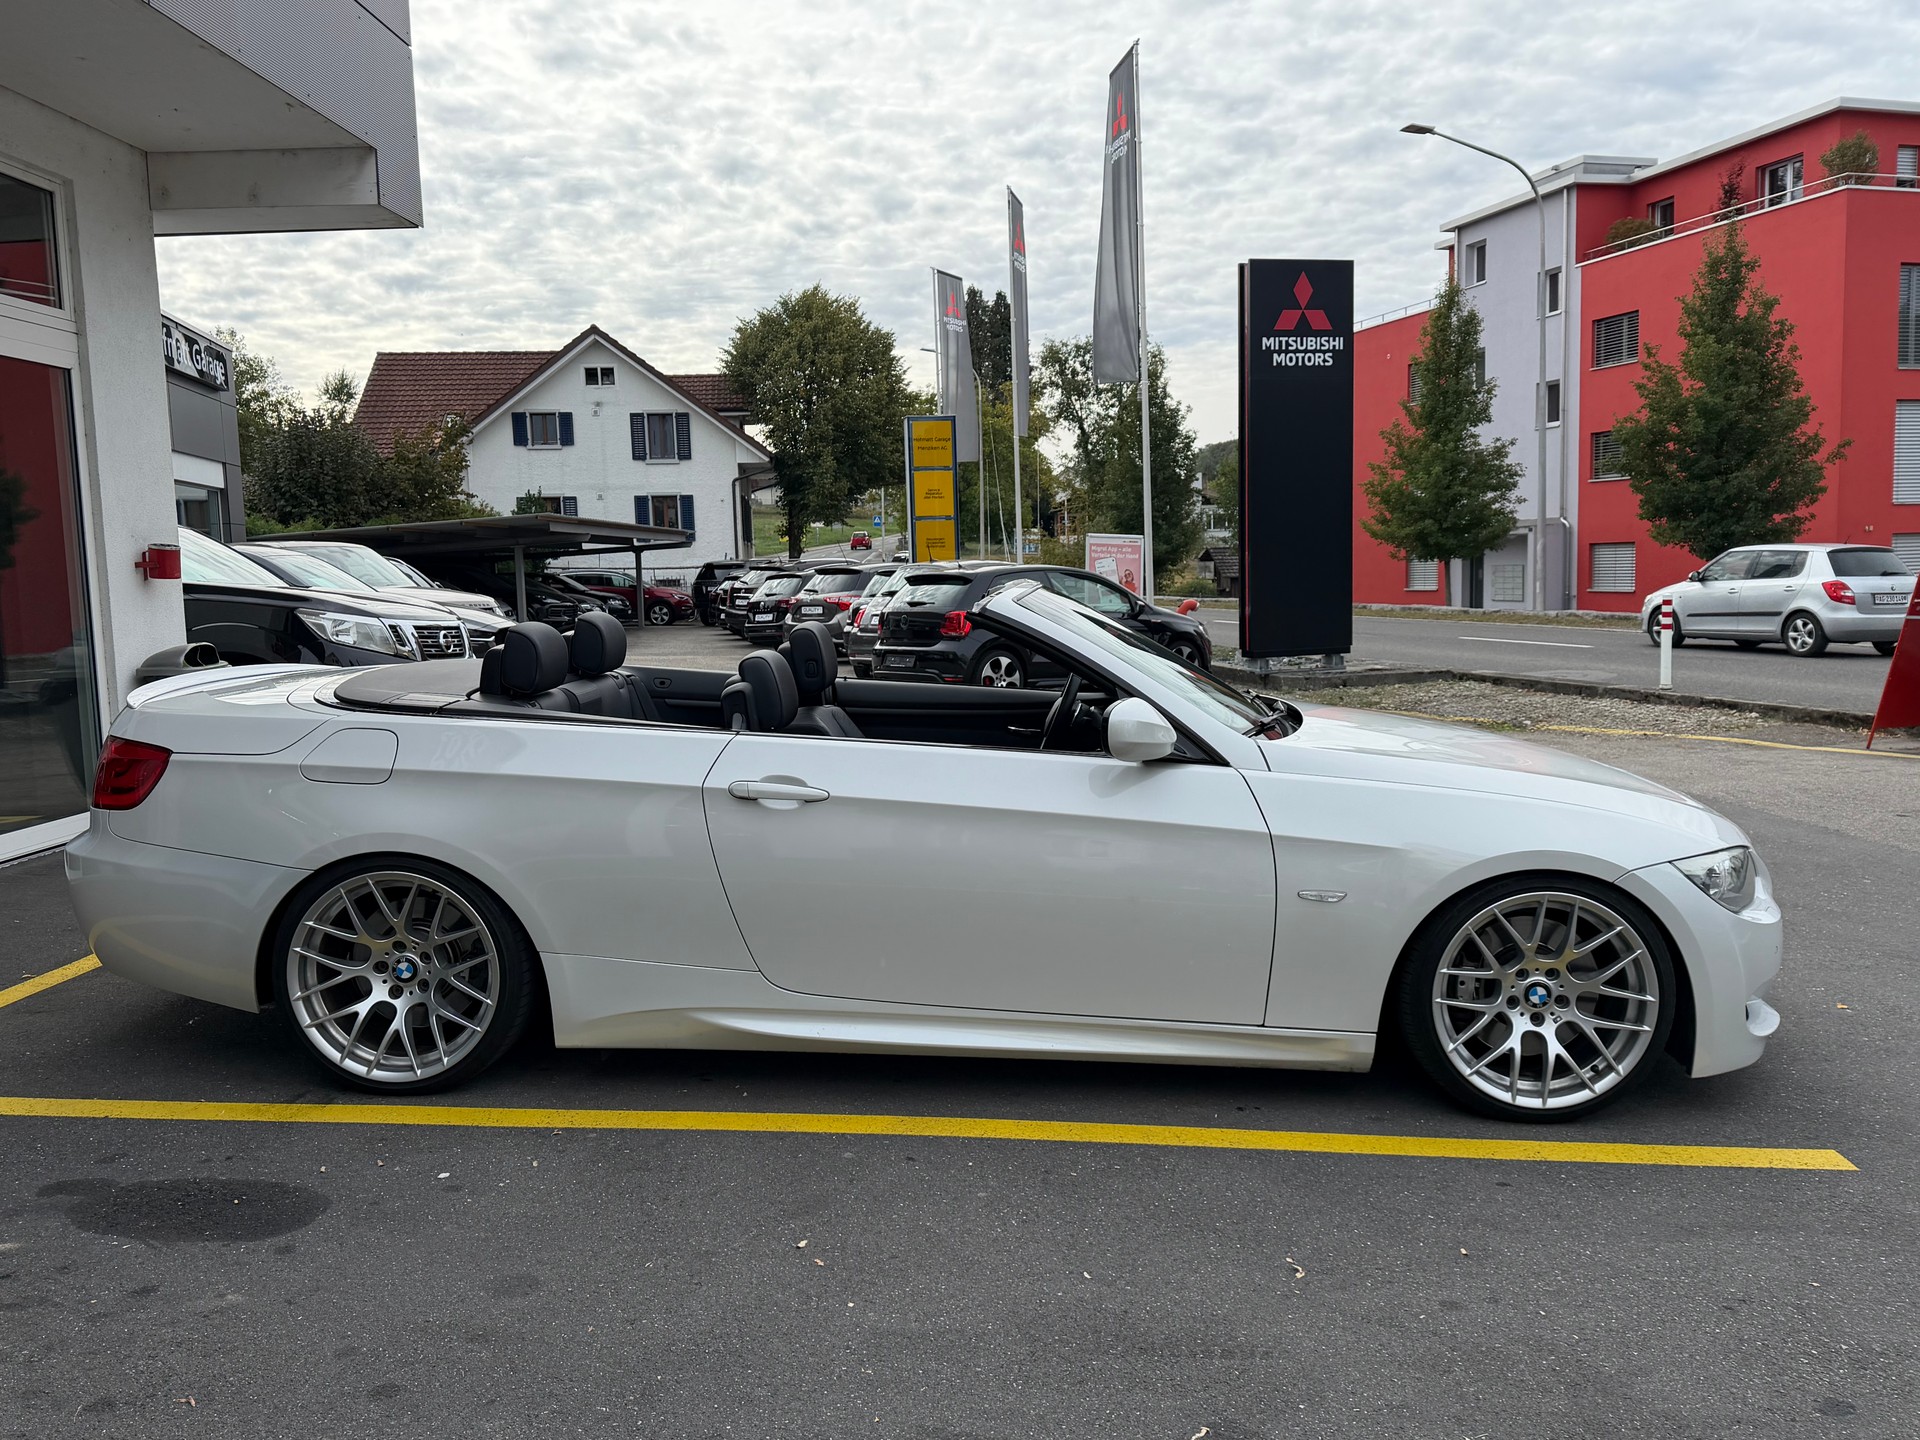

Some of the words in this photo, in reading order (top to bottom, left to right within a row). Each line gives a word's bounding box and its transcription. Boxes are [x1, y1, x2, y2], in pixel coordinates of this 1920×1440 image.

[1261, 336, 1344, 351] MITSUBISHI
[192, 344, 226, 385] Garage
[1272, 352, 1334, 367] MOTORS
